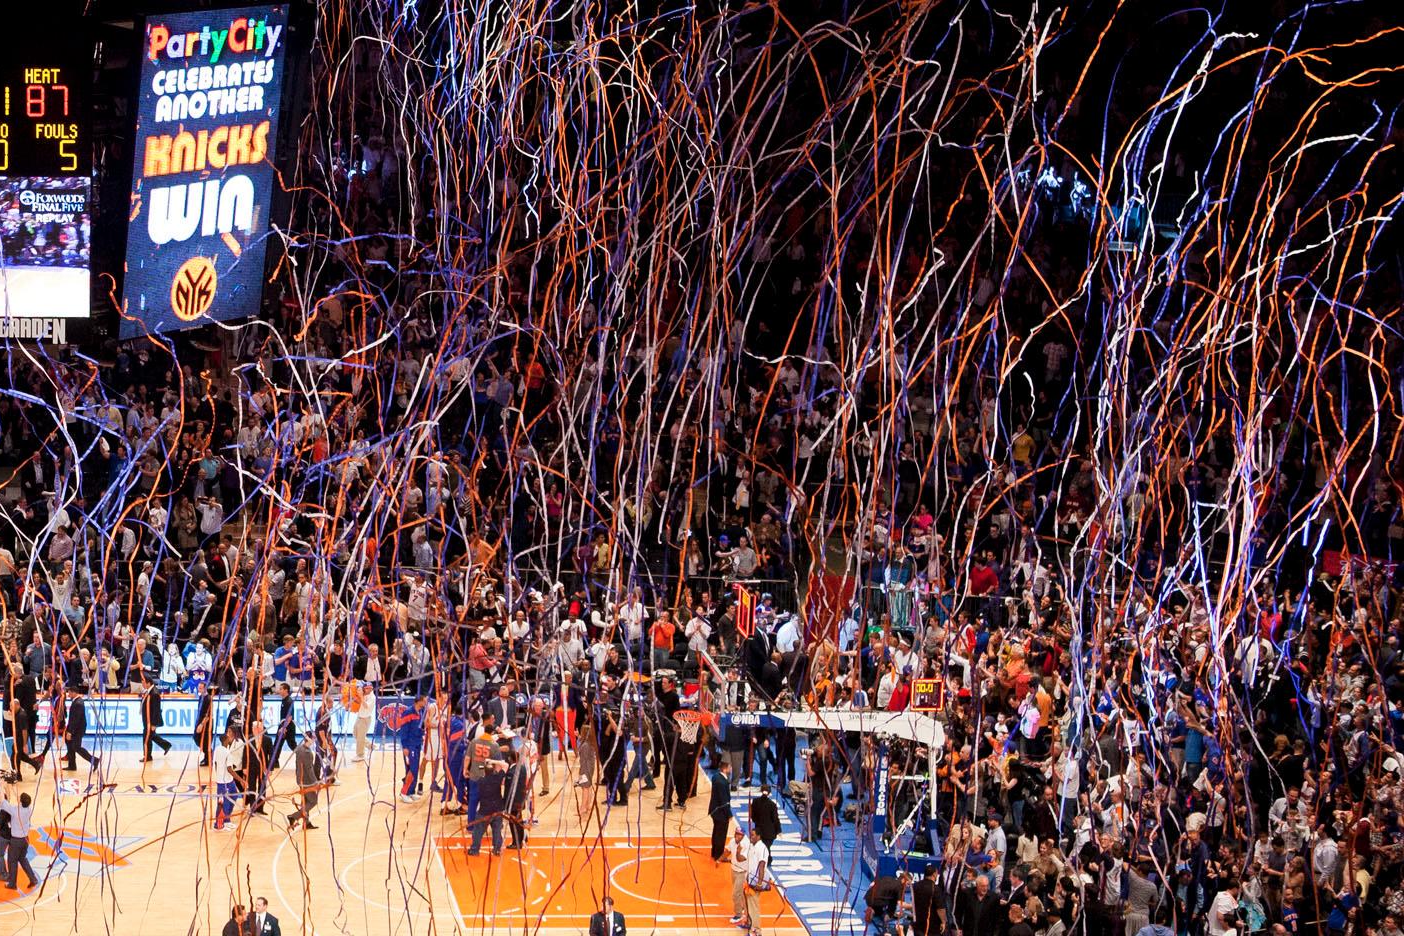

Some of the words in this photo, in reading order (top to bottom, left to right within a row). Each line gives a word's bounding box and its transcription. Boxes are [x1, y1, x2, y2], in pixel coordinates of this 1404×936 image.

[25, 69, 60, 84] HEAT
[152, 59, 274, 96] CELEBRATES
[26, 85, 68, 117] 87
[155, 85, 264, 122] ANOTHER
[36, 124, 78, 139] FOULS
[60, 140, 77, 171] 5
[144, 121, 270, 177] KNICKS
[36, 193, 85, 203] FOXWOODS
[148, 174, 255, 245] WIN
[36, 213, 74, 223] REPLAY
[731, 713, 761, 725] @NBA
[475, 743, 491, 758] 55
